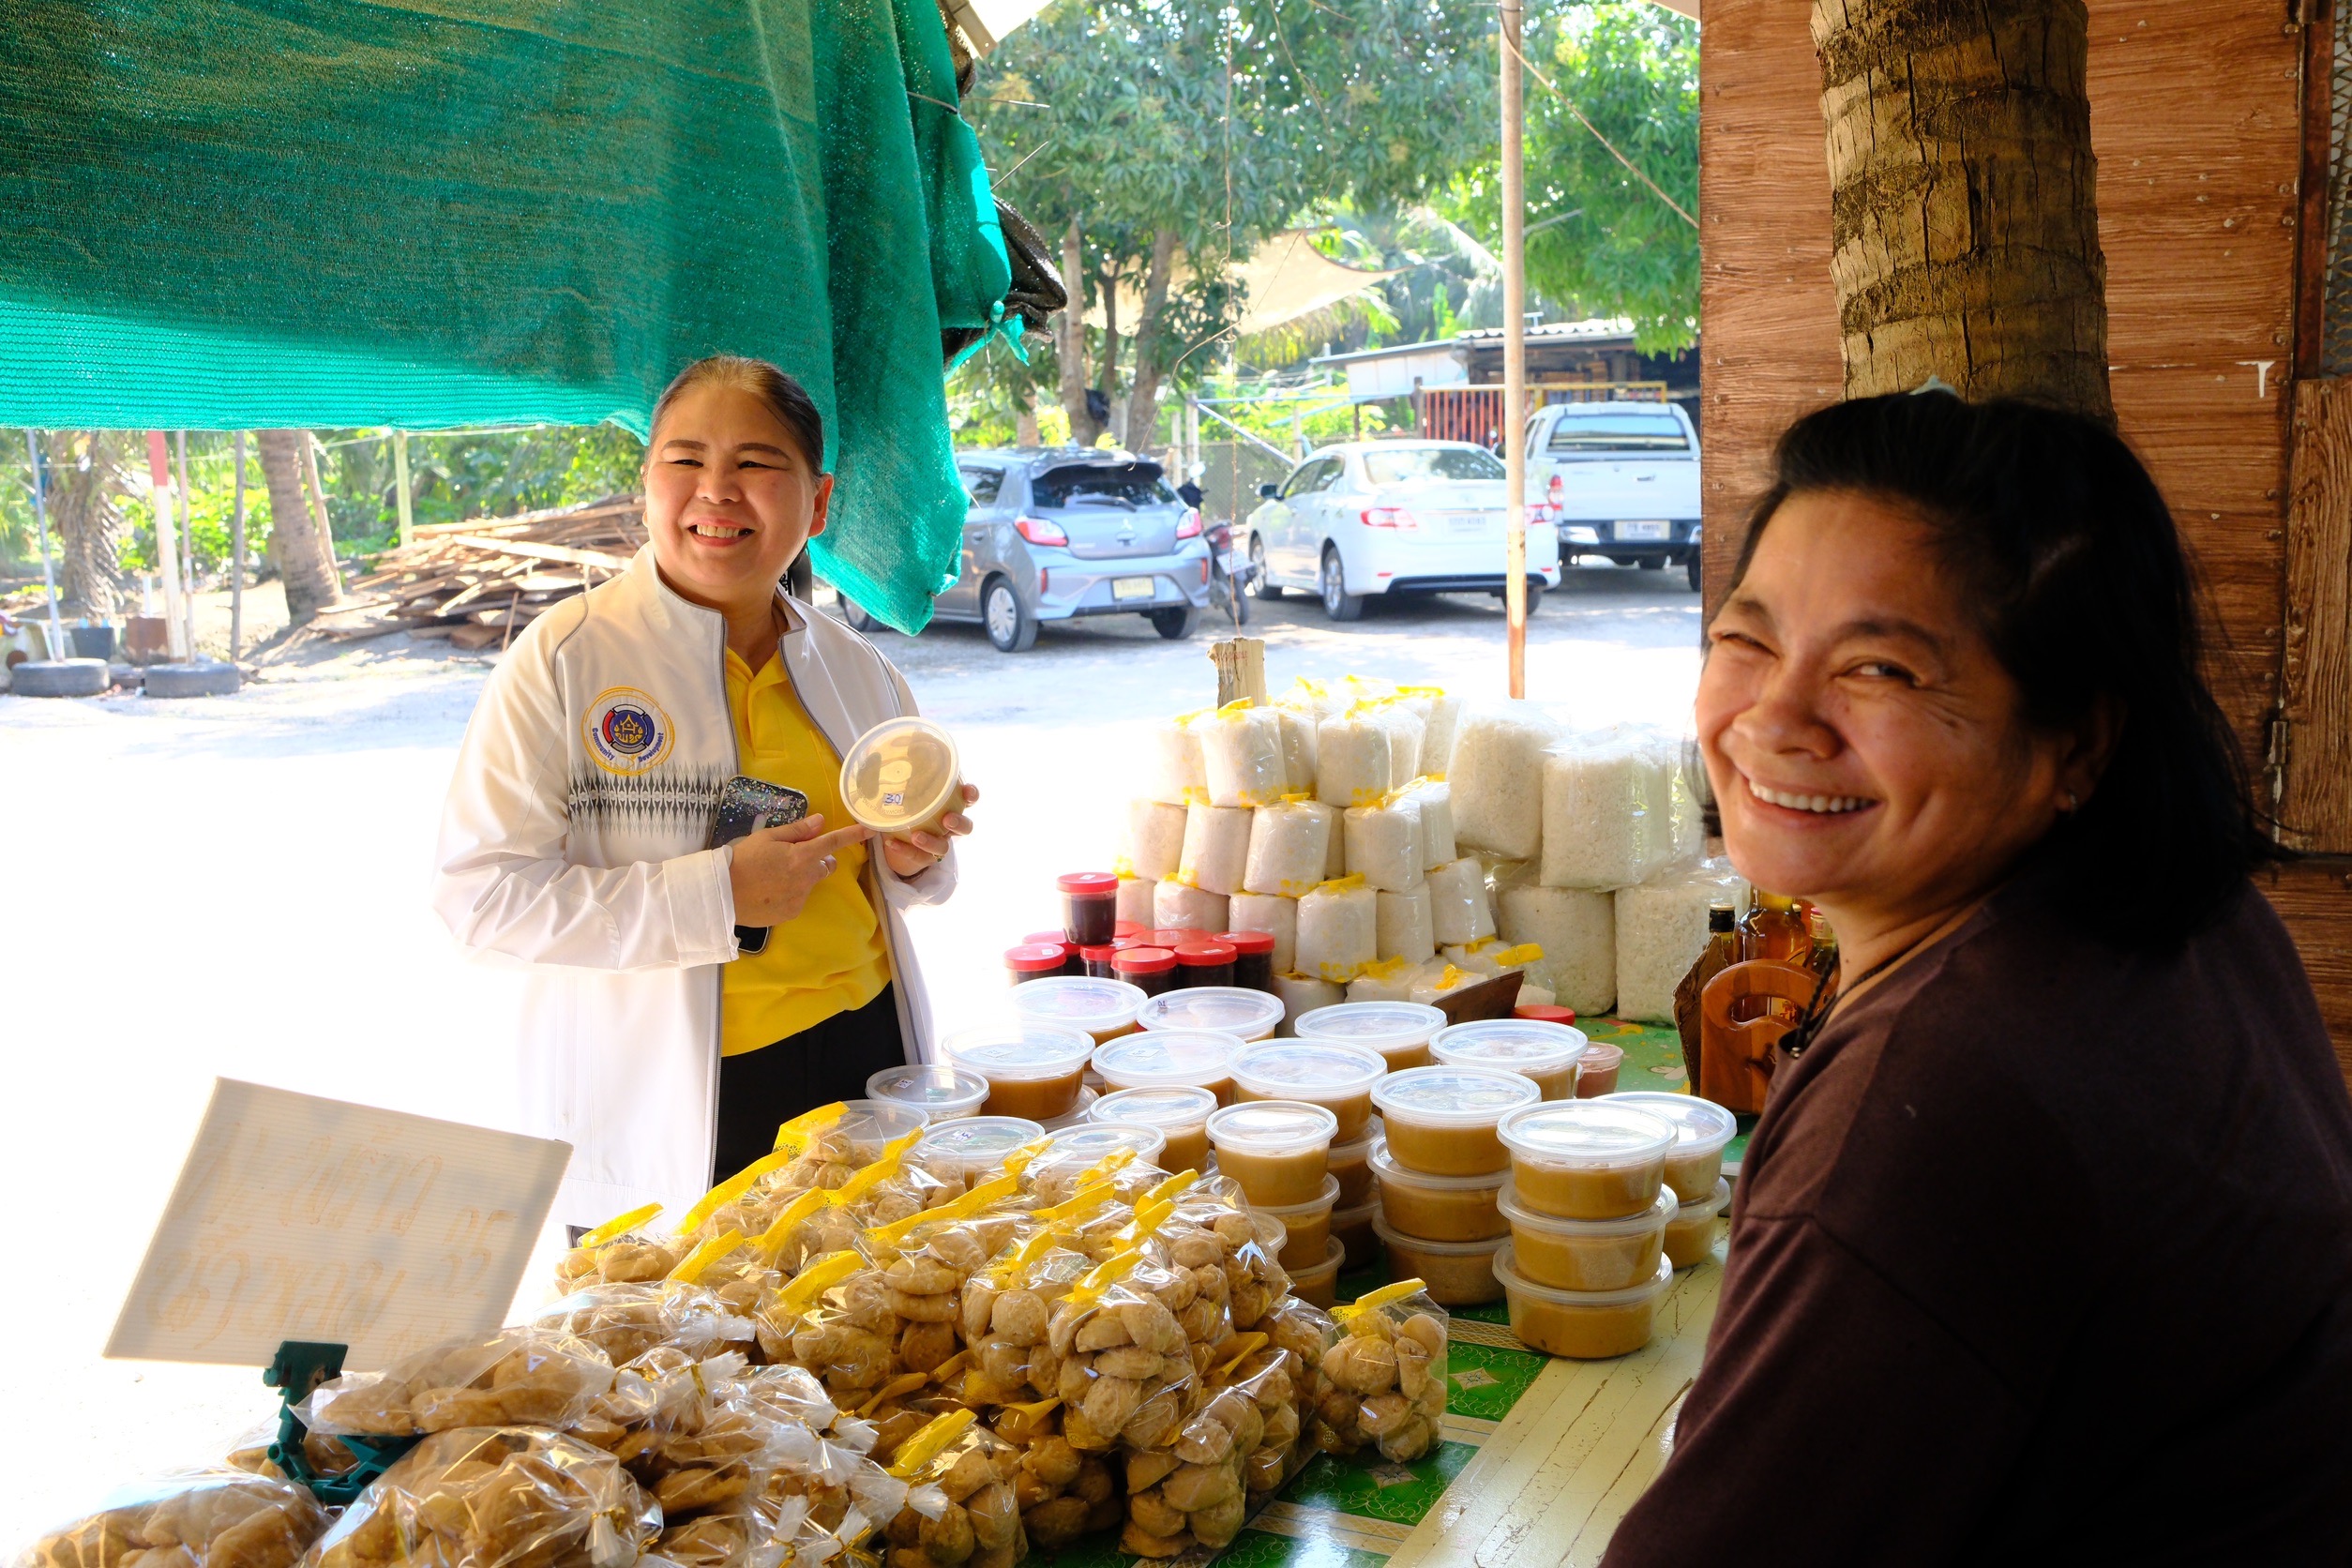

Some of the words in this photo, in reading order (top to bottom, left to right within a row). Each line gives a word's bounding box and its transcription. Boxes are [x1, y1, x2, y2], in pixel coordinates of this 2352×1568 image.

[592, 728, 615, 761] Community
[638, 731, 664, 762] Development
[885, 793, 902, 805] 30
